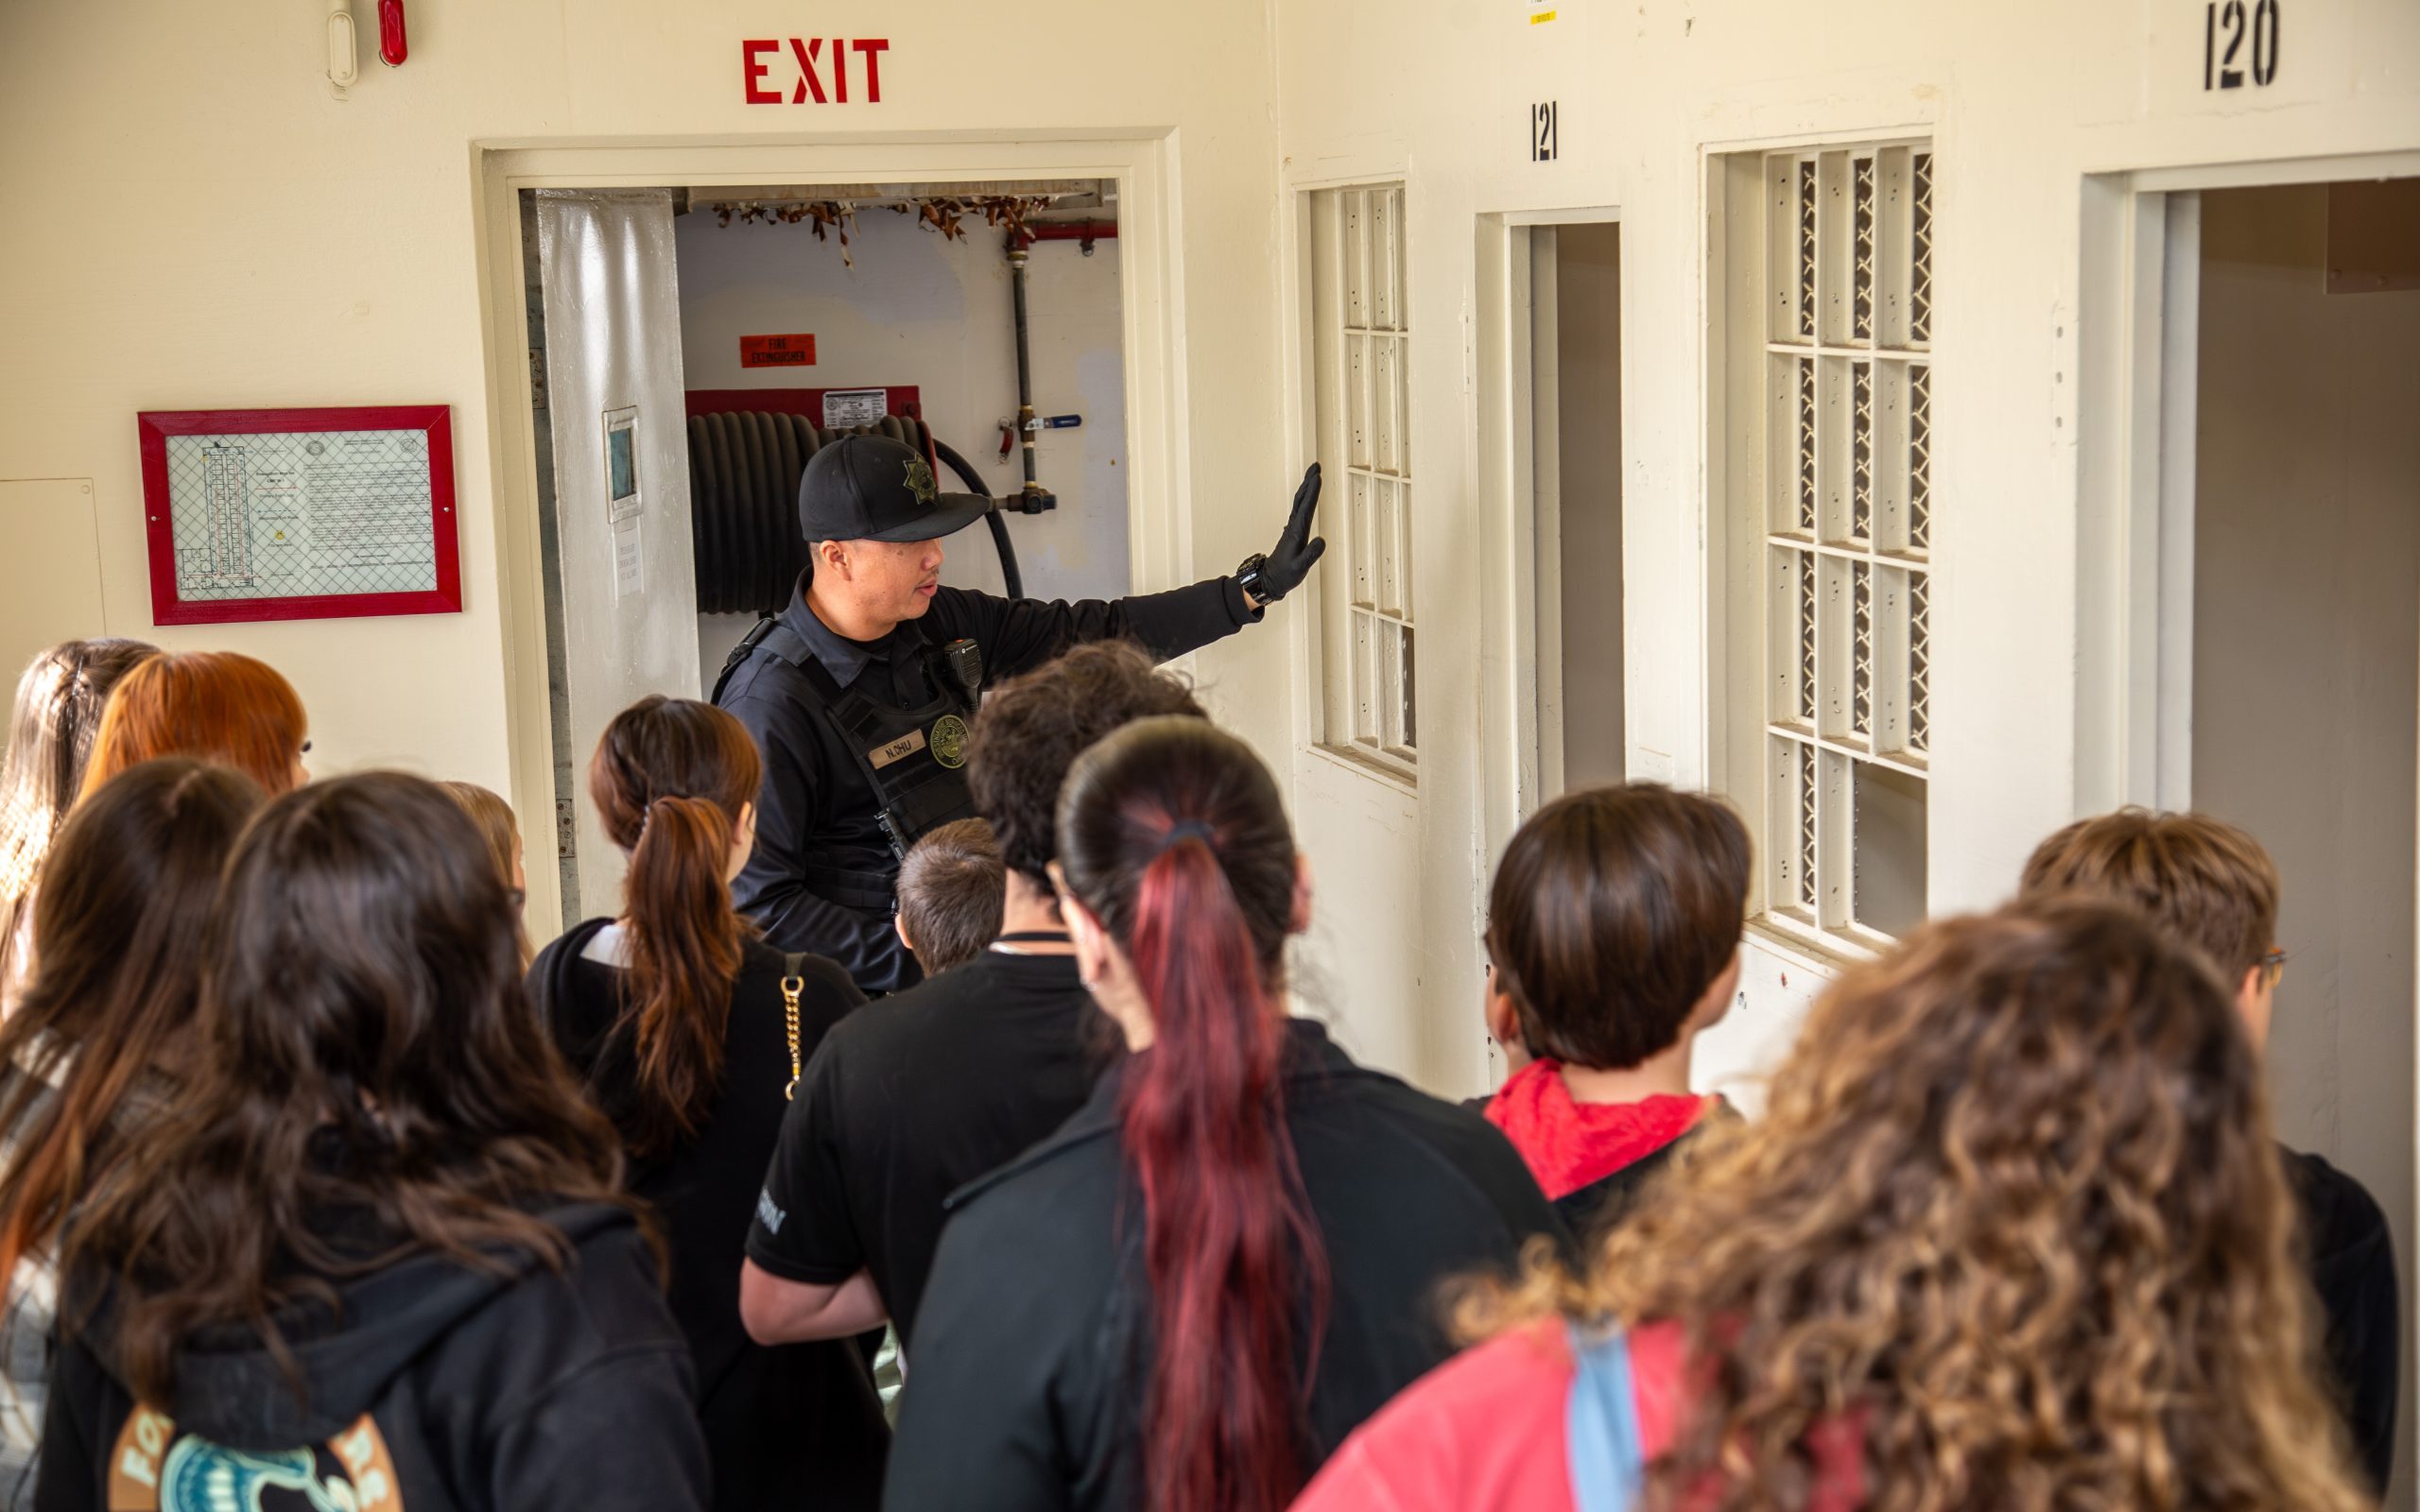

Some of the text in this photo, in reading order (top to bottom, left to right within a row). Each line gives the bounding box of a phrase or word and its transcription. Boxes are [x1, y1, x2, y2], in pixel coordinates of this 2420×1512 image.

[742, 38, 890, 104] EXIT
[2204, 0, 2280, 91] 120
[1531, 100, 1557, 162] 121
[752, 351, 805, 364] EXTINGUISHER
[769, 337, 786, 350] FIRE
